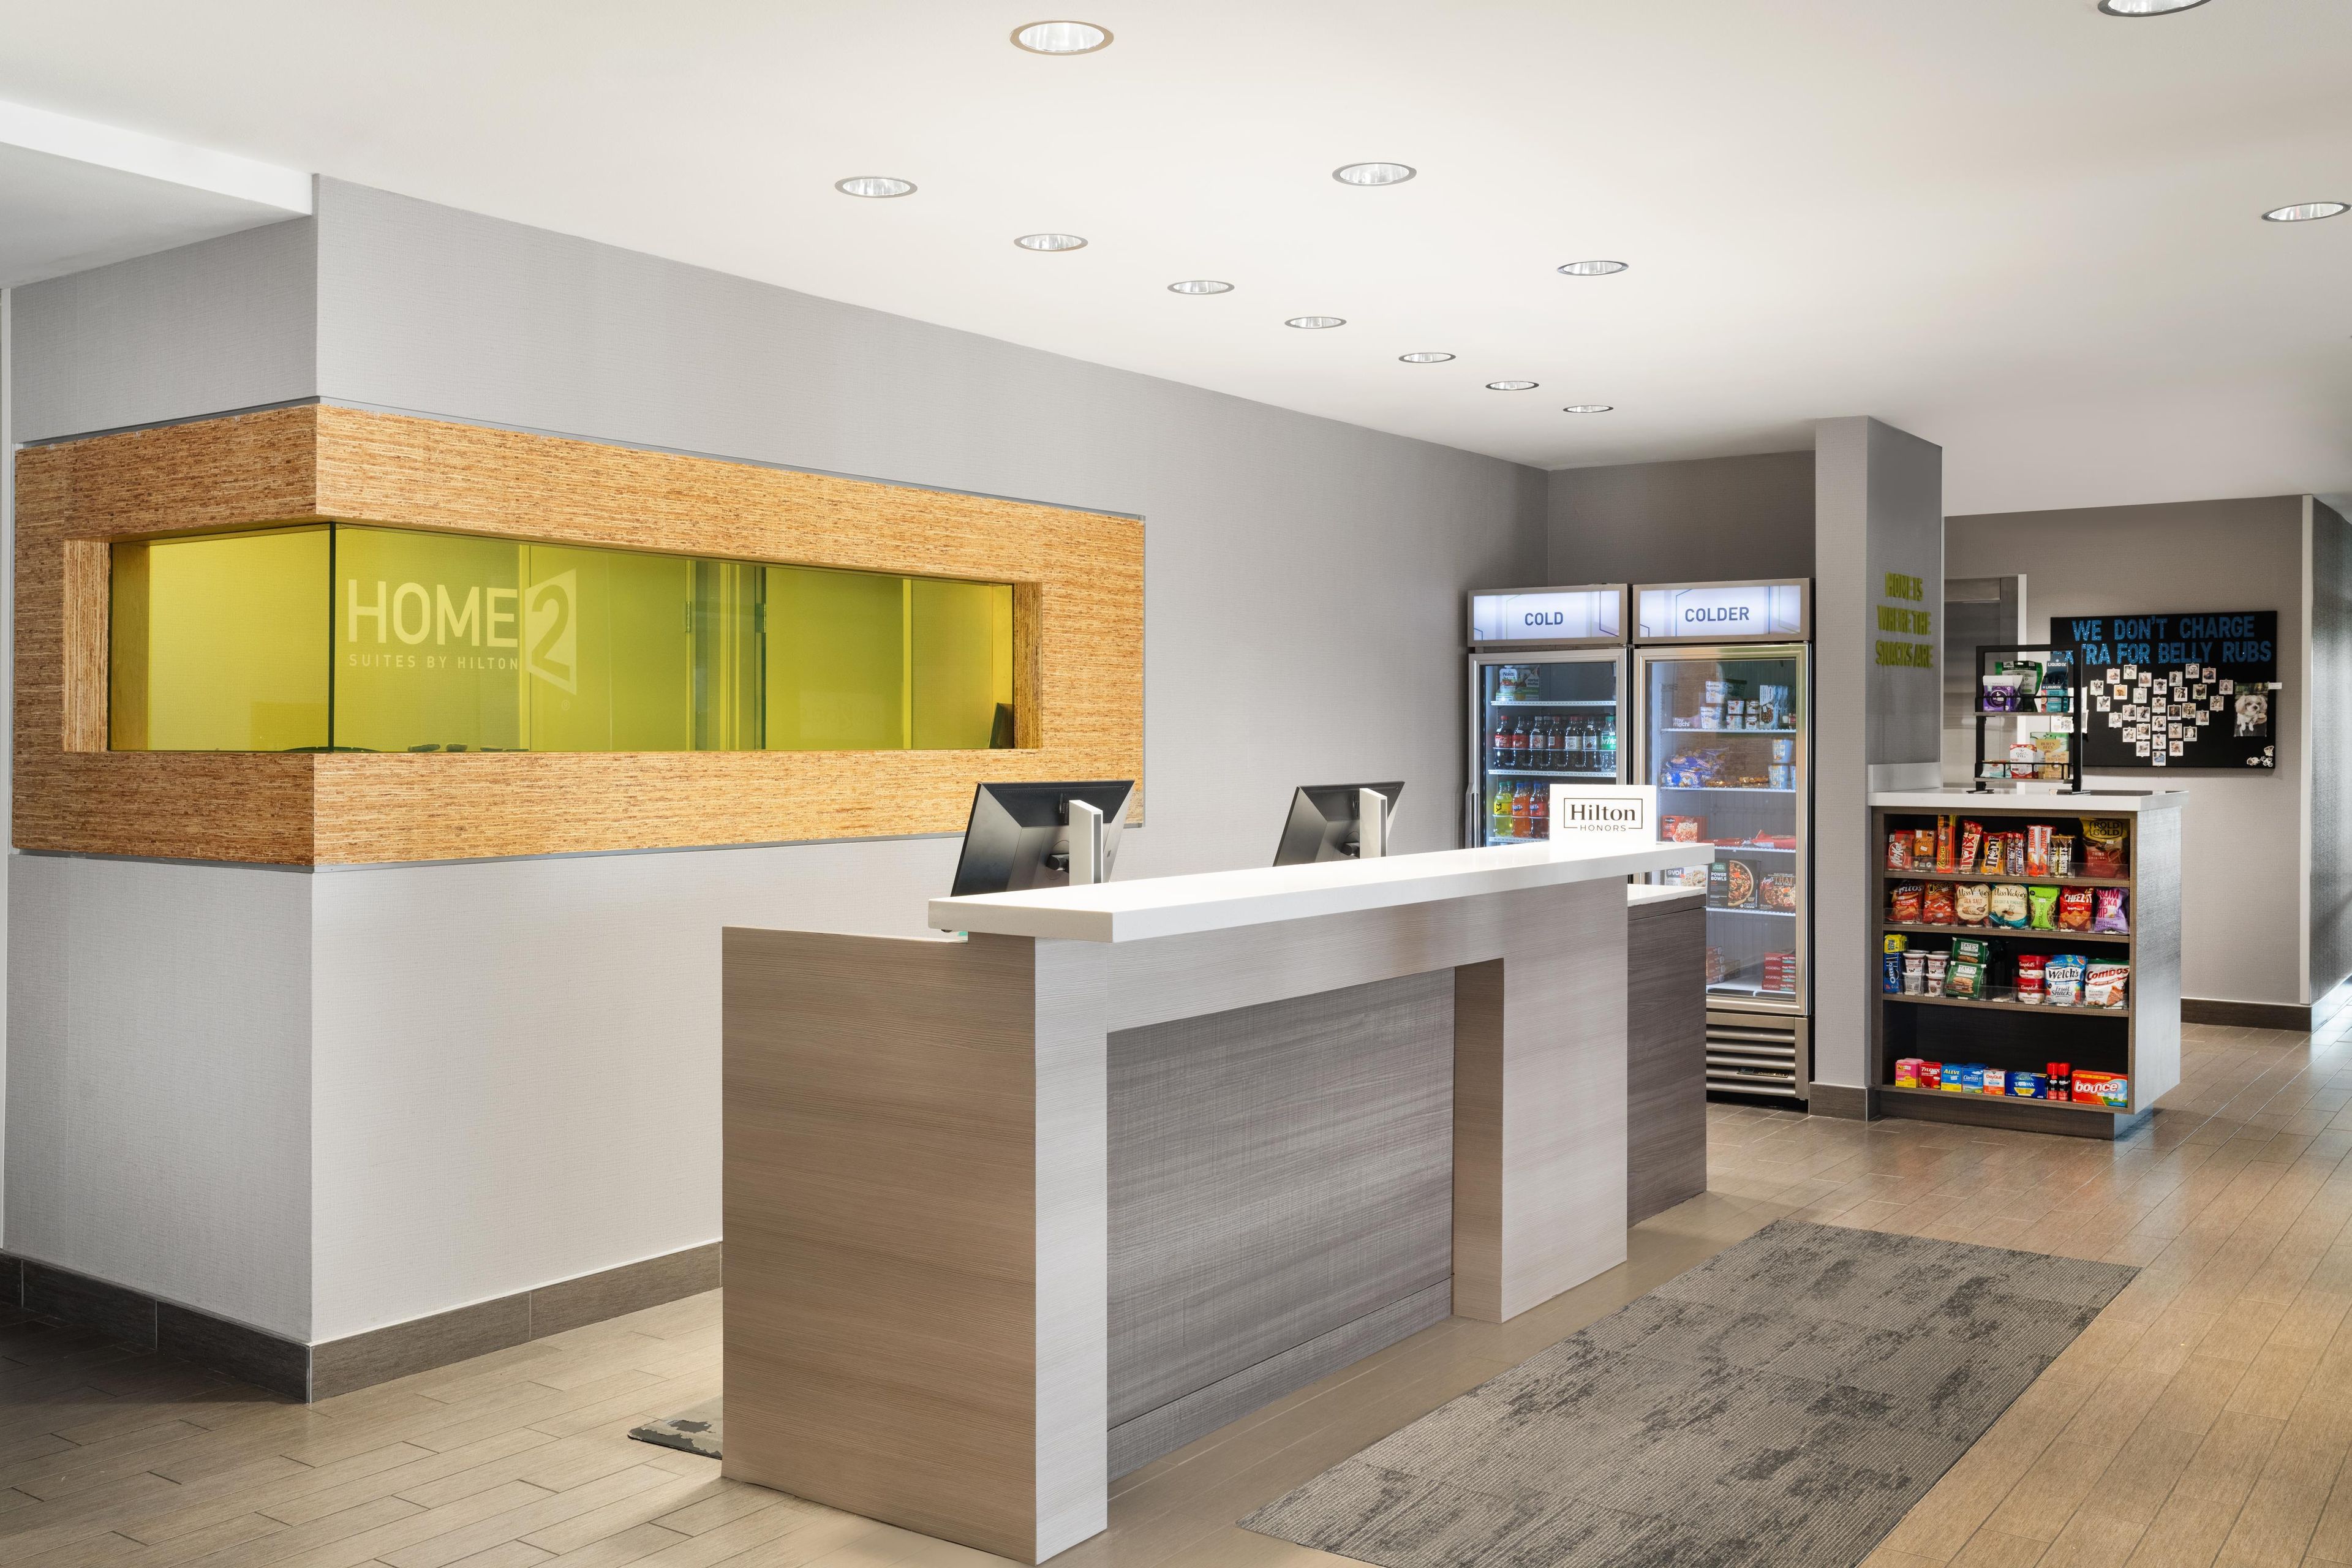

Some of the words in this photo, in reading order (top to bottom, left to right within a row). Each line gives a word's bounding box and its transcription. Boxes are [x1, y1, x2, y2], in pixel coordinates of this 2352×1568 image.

[1885, 571, 1913, 601] HOME
[1913, 577, 1923, 601] IS
[1525, 611, 1564, 626] COLD
[1685, 606, 1750, 622] COLDER
[1877, 604, 1912, 633] WHERE
[1912, 611, 1931, 635] THE
[2071, 619, 2102, 642] WE
[2114, 616, 2168, 641] DON'T
[2180, 615, 2255, 639] CHARGE
[1875, 639, 1913, 666] SNACKS
[1913, 643, 1934, 668] ARE
[2117, 643, 2150, 665] FOR
[2158, 641, 2213, 665] BELLY
[2222, 640, 2272, 663] RUBS
[349, 654, 416, 669] SUITES
[427, 655, 447, 669] BY
[458, 657, 518, 670] HILTON
[1570, 804, 1636, 821] Hilton
[1928, 883, 1953, 895] Cheetos
[1959, 888, 1970, 897] Miss
[2006, 888, 2026, 900] Vickie's
[2049, 968, 2079, 979] Welch's
[2087, 968, 2129, 981] Combos
[2075, 1080, 2119, 1094] bounce
